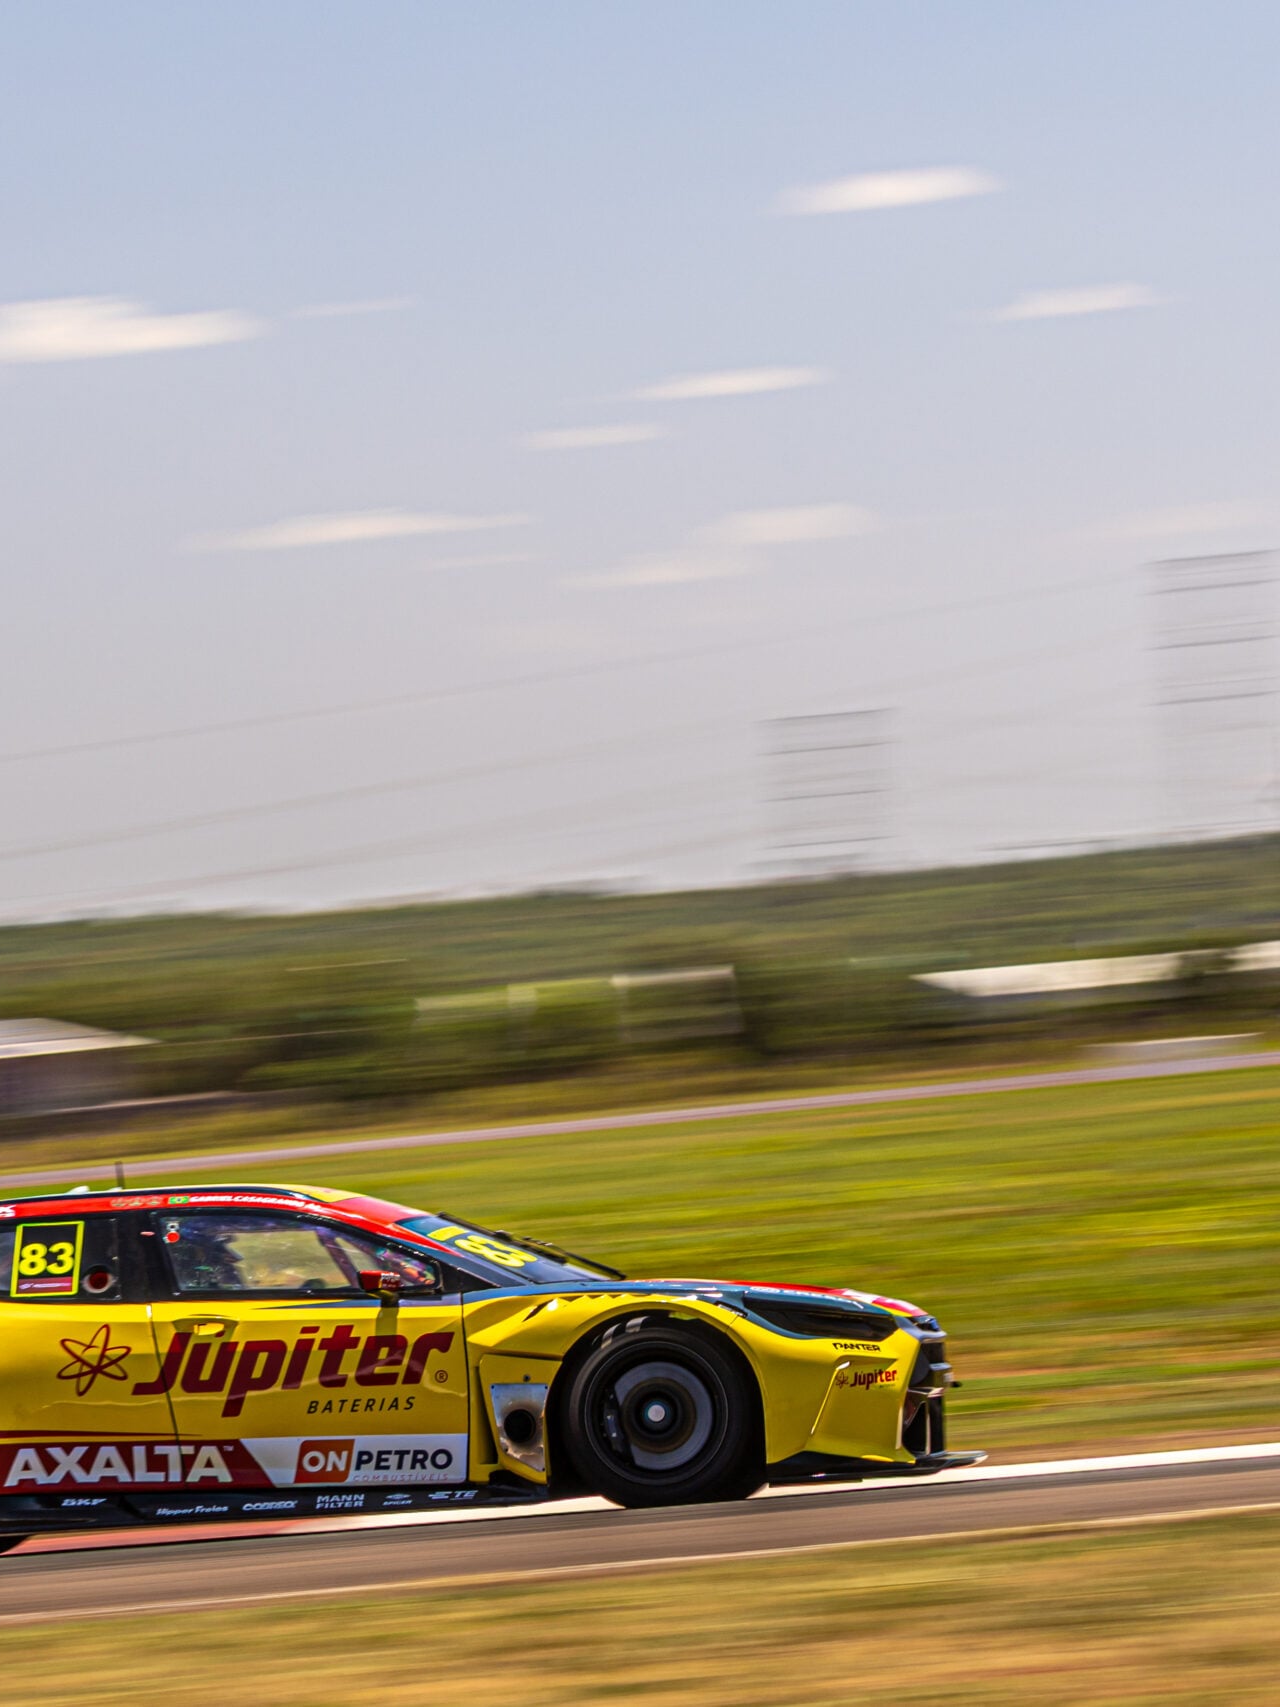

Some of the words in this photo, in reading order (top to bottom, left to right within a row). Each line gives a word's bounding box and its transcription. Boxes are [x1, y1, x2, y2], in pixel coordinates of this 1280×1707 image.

[18, 1241, 75, 1275] 83
[455, 1235, 538, 1267] 83
[832, 1342, 881, 1352] PANTER
[307, 1396, 416, 1415] BATERIAS
[3, 1445, 234, 1487] AXALTA
[316, 1501, 364, 1509] FILTER
[317, 1494, 365, 1503] MANN
